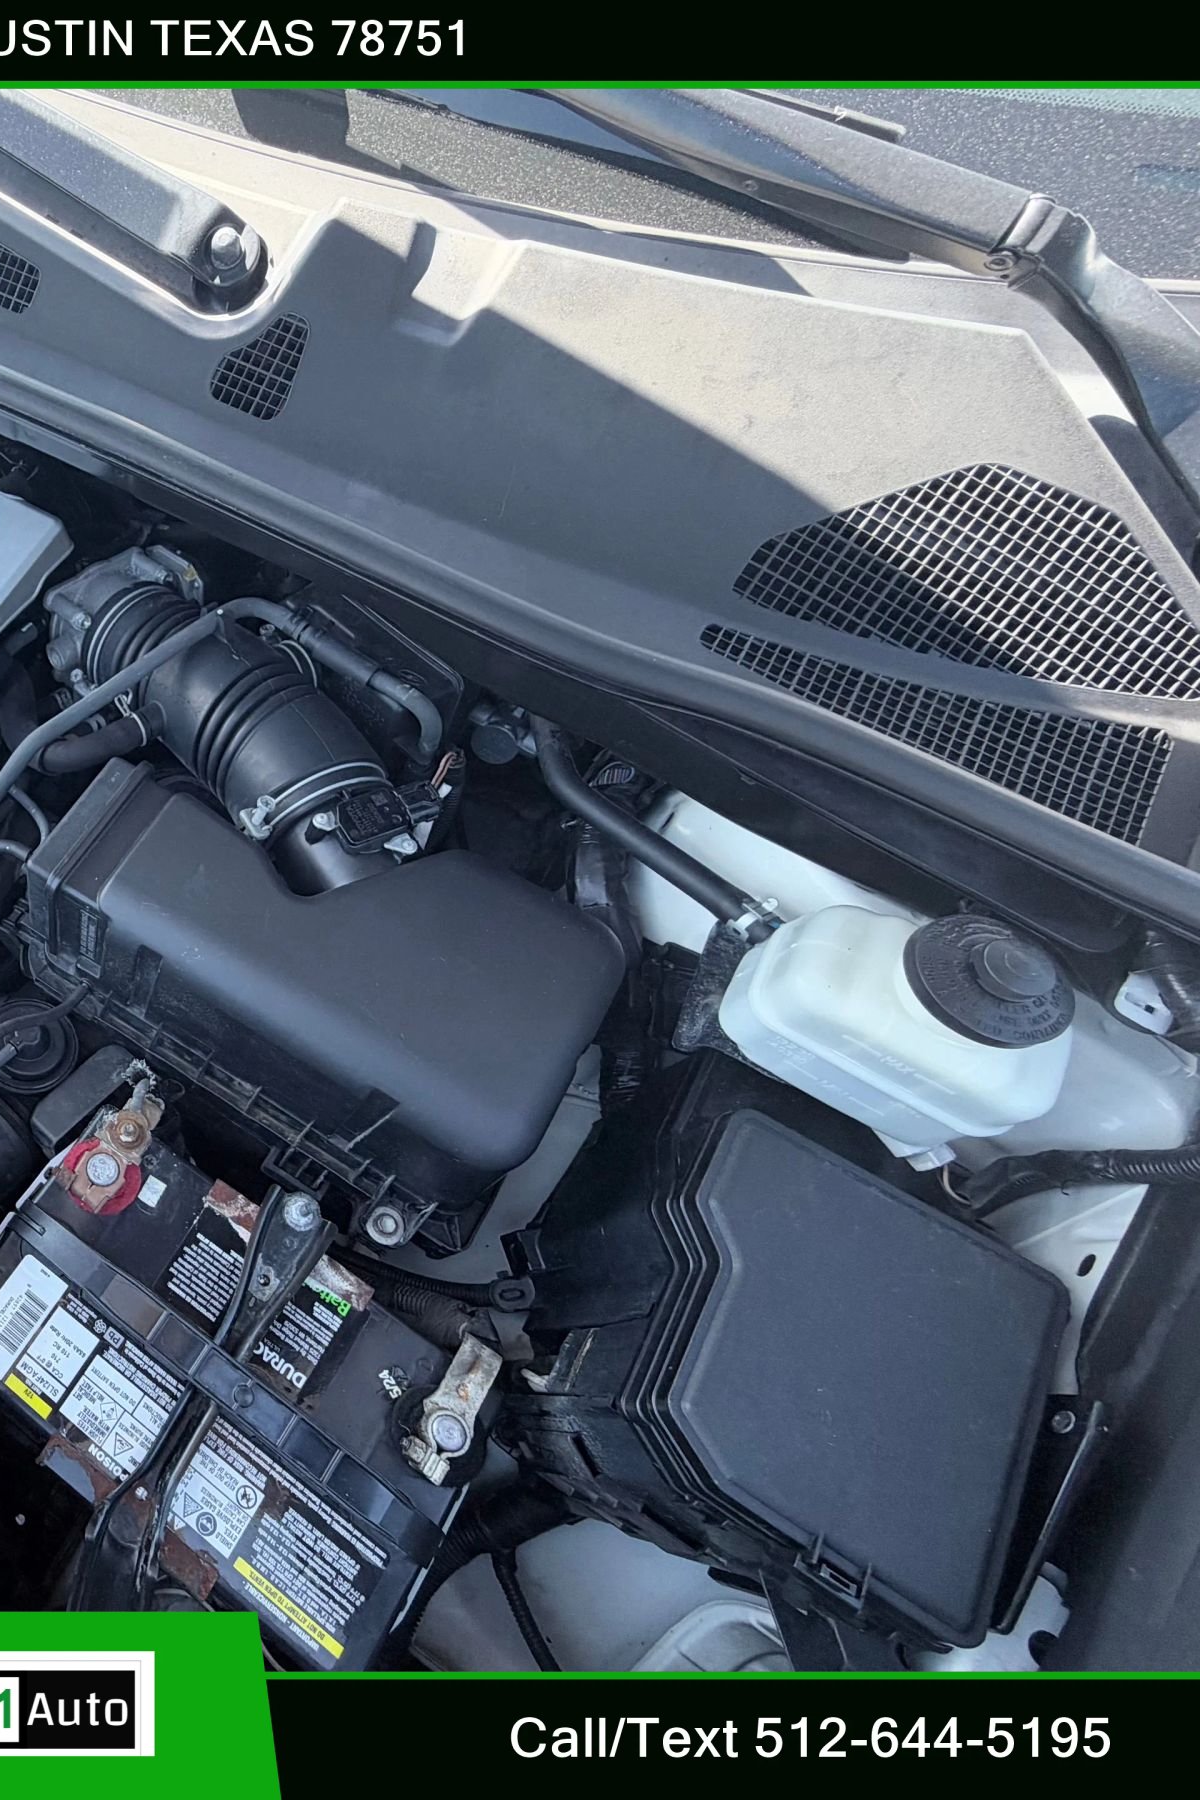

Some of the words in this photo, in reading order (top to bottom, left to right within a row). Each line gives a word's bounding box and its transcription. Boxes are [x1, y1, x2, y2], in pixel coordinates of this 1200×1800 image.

[48, 1323, 61, 1338] Rate
[106, 1329, 120, 1345] Pb
[51, 1339, 62, 1350] RC
[59, 1333, 73, 1347] 20Hr
[262, 1336, 281, 1353] ULTRA
[49, 1351, 61, 1364] 710
[59, 1346, 71, 1358] 110
[251, 1339, 308, 1389] DURAC
[19, 1360, 59, 1397] SLI24FAGM
[50, 1365, 64, 1379] CCA
[108, 1380, 121, 1393] OPEN
[377, 1369, 401, 1399] 5/24
[22, 1387, 34, 1399] 12V
[72, 1389, 83, 1401] GET
[76, 1384, 97, 1404] MEDICAL
[92, 1388, 105, 1402] HELP
[118, 1389, 130, 1401] NOT
[128, 1397, 136, 1406] DO
[76, 1409, 106, 1439] IMMEDIATELY
[76, 1418, 89, 1432] EYES
[97, 1418, 110, 1432] WITH
[87, 1428, 103, 1444] FLUSH
[86, 1442, 129, 1482] POISON
[198, 1458, 209, 1469] THE
[216, 1464, 224, 1473] OF
[207, 1465, 215, 1474] OF
[213, 1471, 224, 1482] OUT
[223, 1470, 239, 1486] REACH
[223, 1479, 236, 1491] KEEP
[199, 1485, 223, 1508] BLINDNESS
[199, 1495, 217, 1512] GASES
[222, 1505, 237, 1520] CAUSE
[214, 1508, 242, 1534] EXPLOSIVE
[235, 1516, 245, 1527] CAN
[214, 1530, 233, 1550] SHIELD
[221, 1525, 238, 1542] EYES.
[263, 1583, 278, 1599] OPEN
[275, 1594, 285, 1606] TO
[283, 1601, 307, 1625] ATTEMPT
[305, 1620, 318, 1634] NOT
[289, 1621, 320, 1651] IMPORTANT
[315, 1629, 325, 1641] DO
